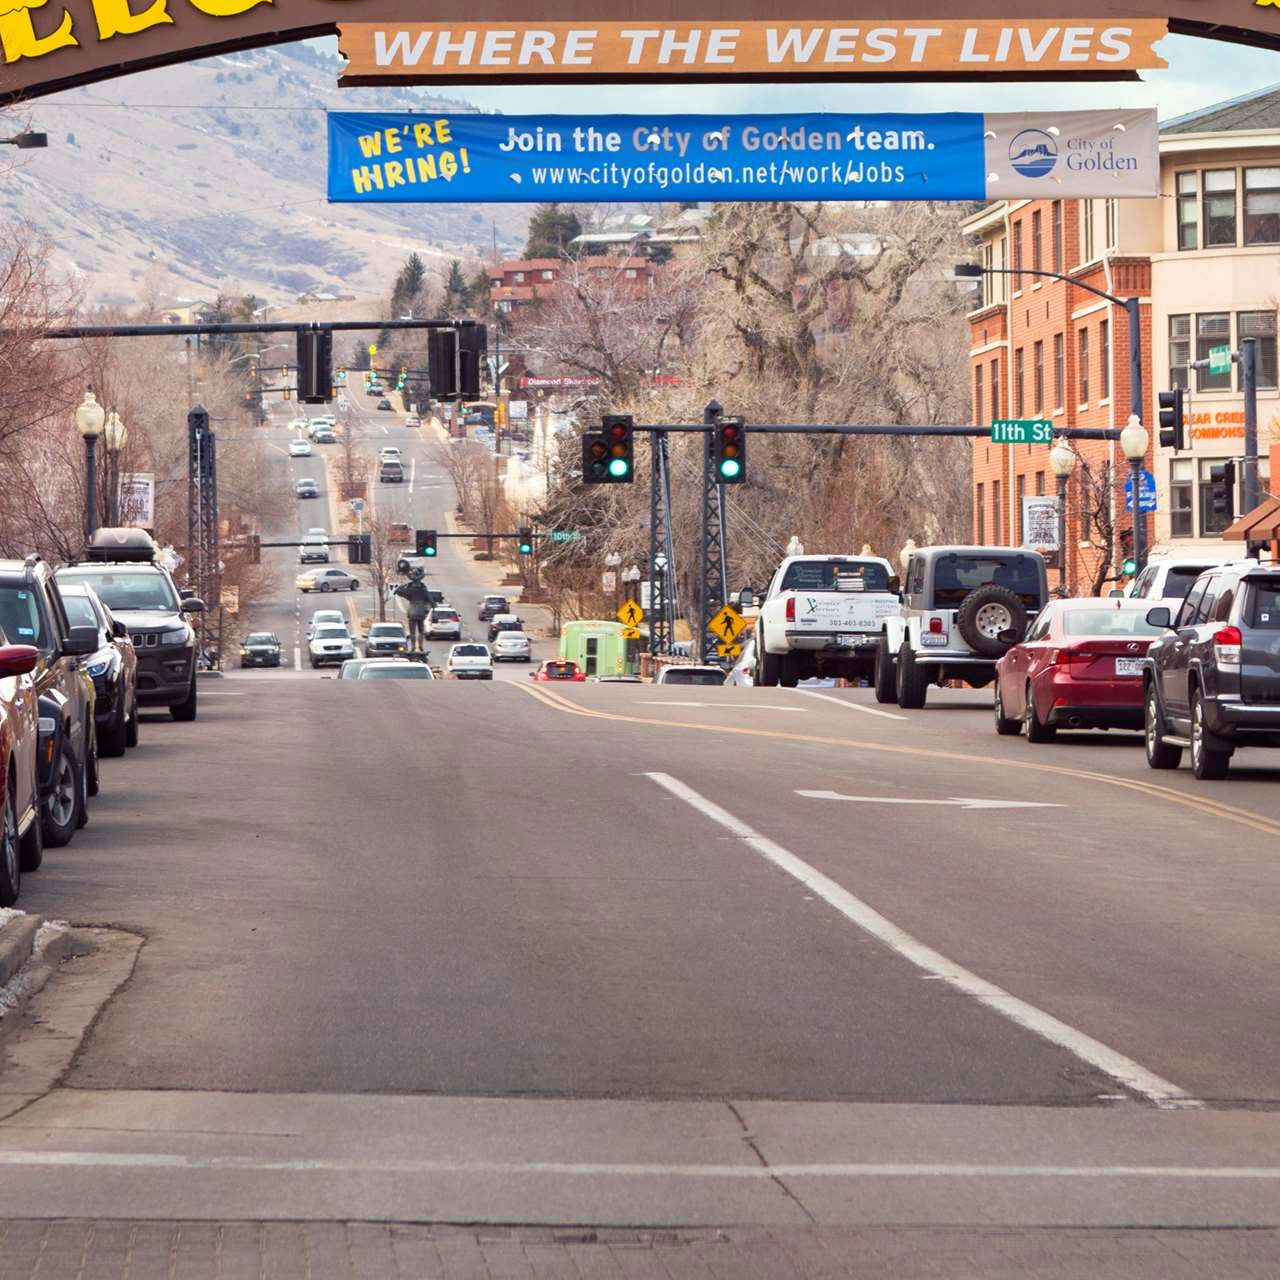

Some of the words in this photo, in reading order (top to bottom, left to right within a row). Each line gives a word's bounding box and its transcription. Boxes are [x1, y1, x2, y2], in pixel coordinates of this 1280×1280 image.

[372, 28, 599, 66] WHERE
[618, 28, 741, 65] THE
[765, 27, 942, 64] WEST
[959, 26, 1134, 63] LIVES
[358, 119, 453, 158] WE'RE
[499, 127, 562, 152] Join
[573, 127, 621, 152] the
[633, 127, 692, 157] City
[703, 127, 731, 151] of
[742, 126, 842, 151] Golden
[852, 125, 935, 151] team.
[1067, 137, 1097, 154] City
[1100, 137, 1113, 151] of
[351, 148, 472, 193] HIRING!
[1066, 152, 1138, 172] Golden
[1183, 413, 1211, 424] LEAR
[1216, 412, 1247, 423] CREE
[993, 423, 1025, 440] 11th
[1032, 423, 1051, 440] St
